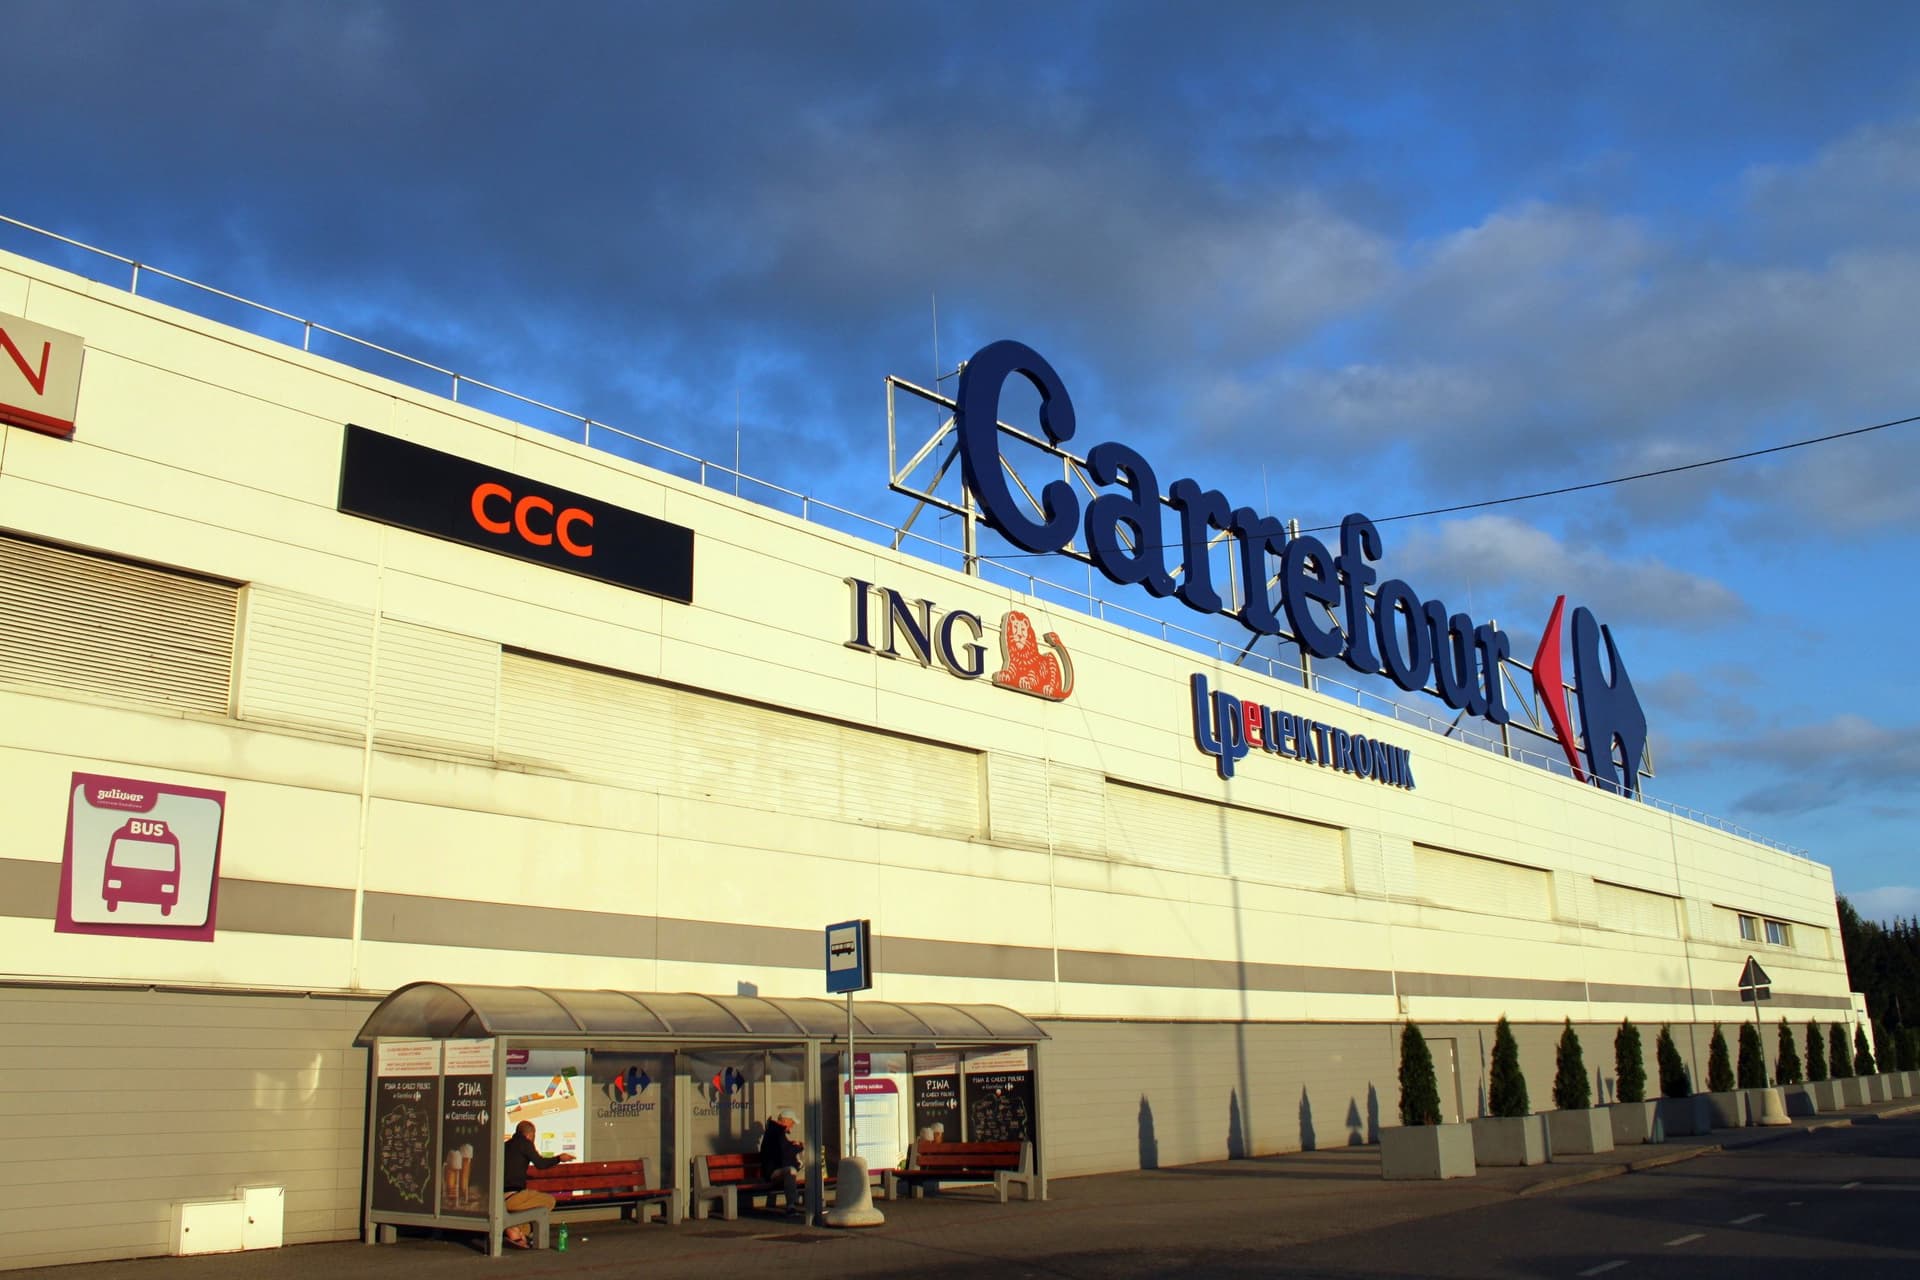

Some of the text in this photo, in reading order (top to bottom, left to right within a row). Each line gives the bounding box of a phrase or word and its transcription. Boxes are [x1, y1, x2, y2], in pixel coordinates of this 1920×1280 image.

[471, 482, 594, 558] CCC
[957, 339, 1511, 725] Carrefour
[843, 576, 988, 680] ING
[130, 820, 164, 837] BUS
[458, 1082, 482, 1096] PIWA
[925, 1079, 950, 1090] PIWA
[610, 1100, 656, 1112] Carrefour
